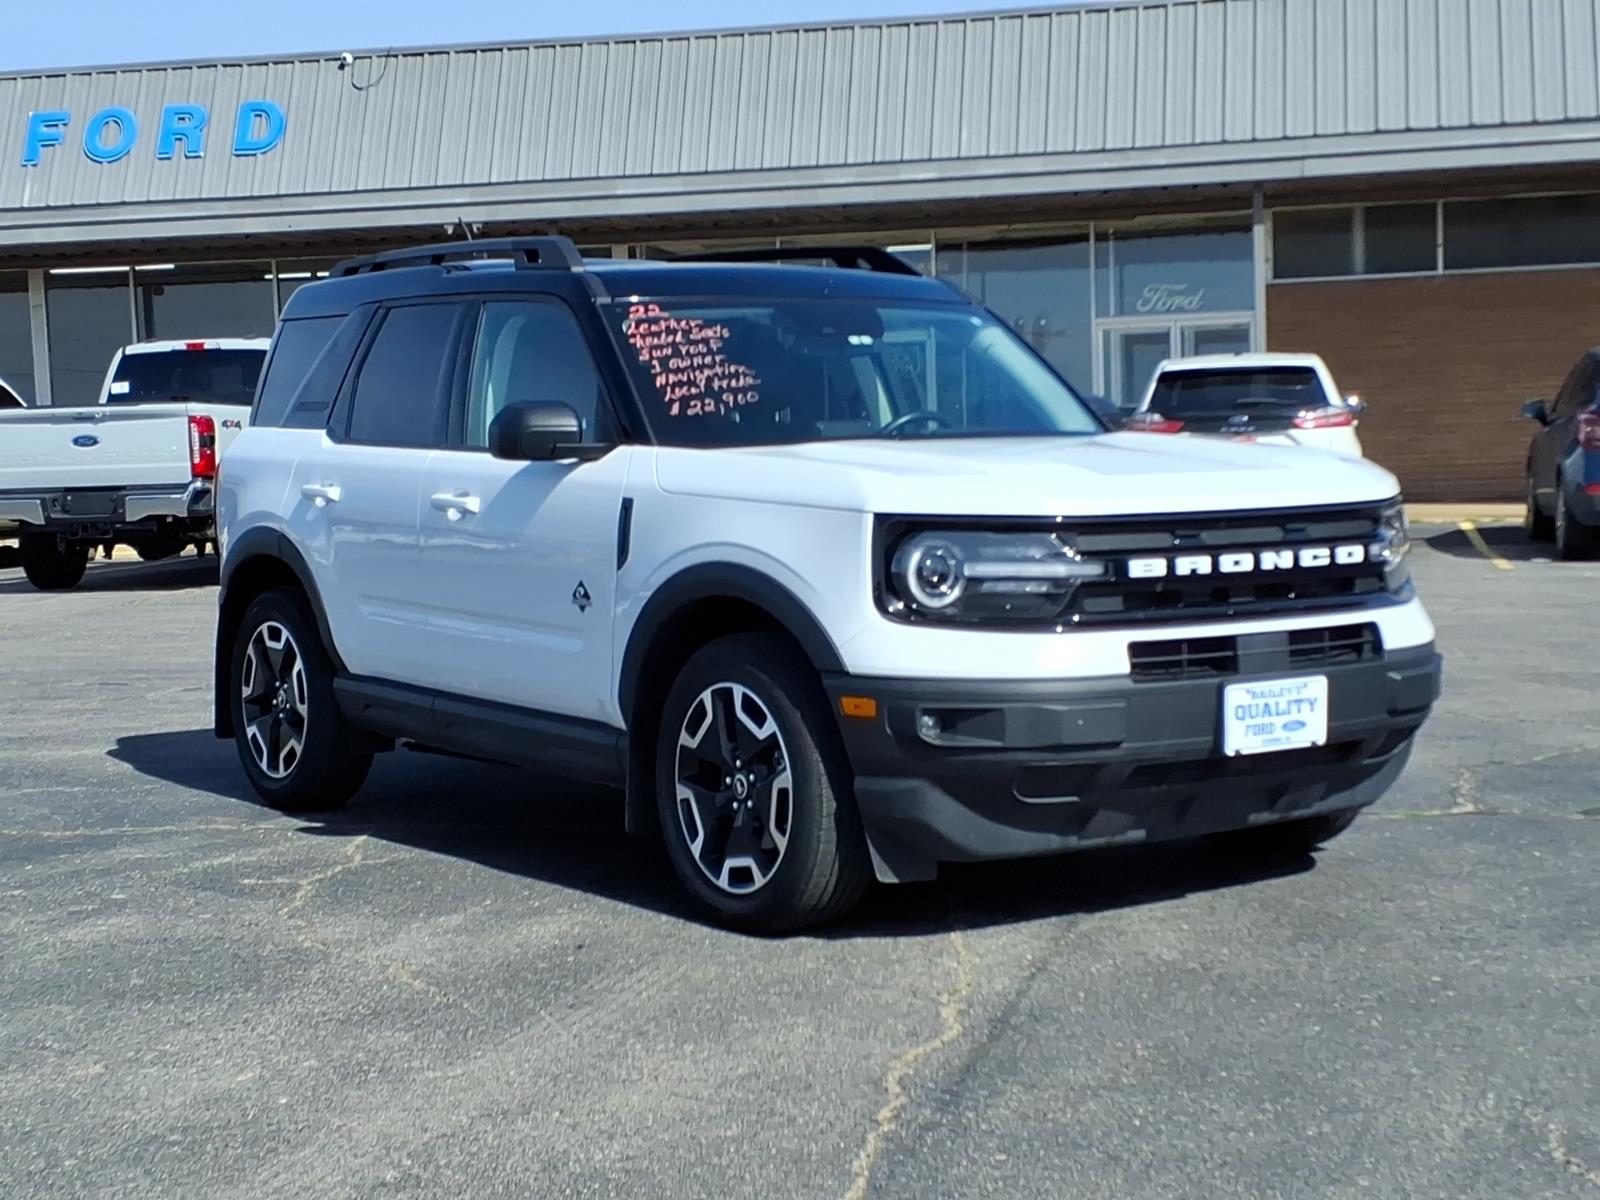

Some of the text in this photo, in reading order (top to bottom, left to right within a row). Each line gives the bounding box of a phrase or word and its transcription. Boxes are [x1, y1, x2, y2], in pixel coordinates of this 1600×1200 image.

[21, 100, 287, 165] FORD
[1136, 282, 1204, 312] Ford
[1127, 544, 1365, 579] BRONCO
[1234, 697, 1318, 721] QUALITY
[1244, 722, 1276, 737] FORD
